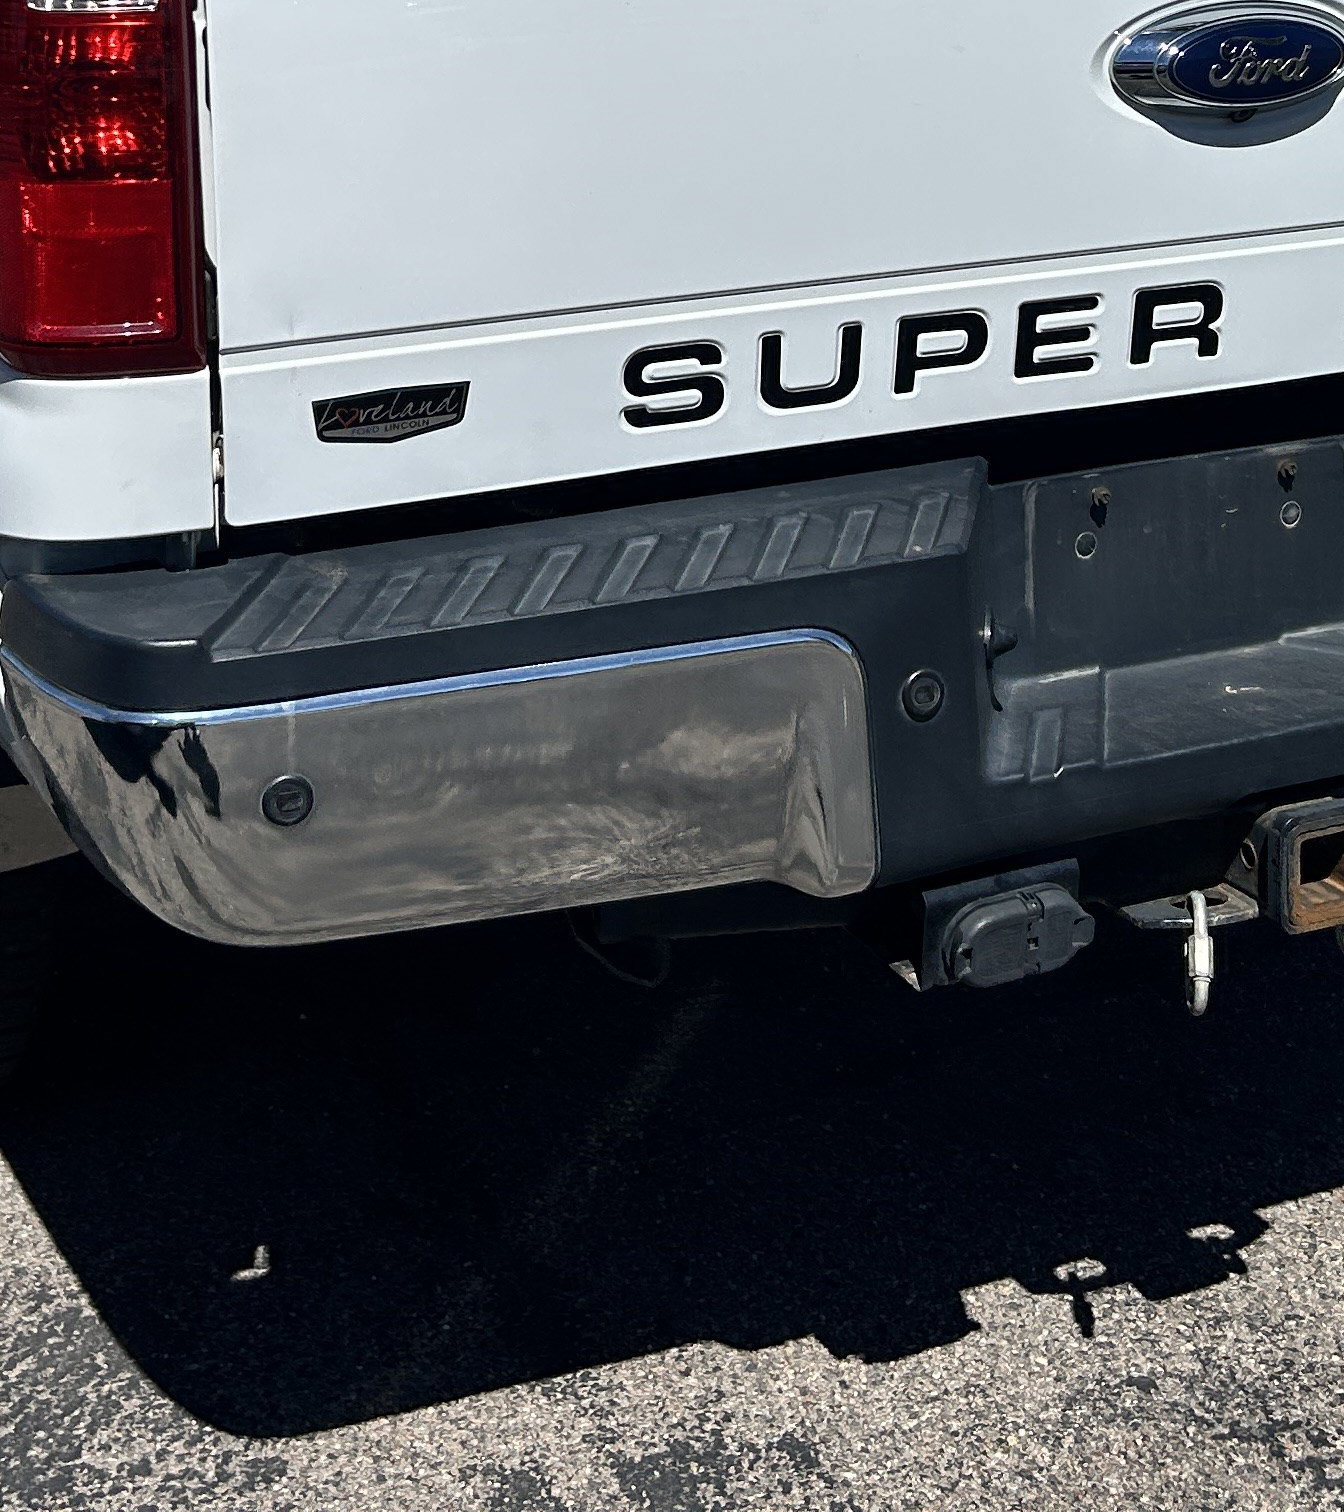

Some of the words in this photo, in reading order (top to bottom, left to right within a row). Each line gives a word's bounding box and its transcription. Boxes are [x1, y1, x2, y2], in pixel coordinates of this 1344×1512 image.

[1209, 35, 1312, 89] Ford
[620, 280, 1226, 429] SUPER
[351, 425, 380, 436] FORD
[384, 419, 430, 433] LINCOLN
